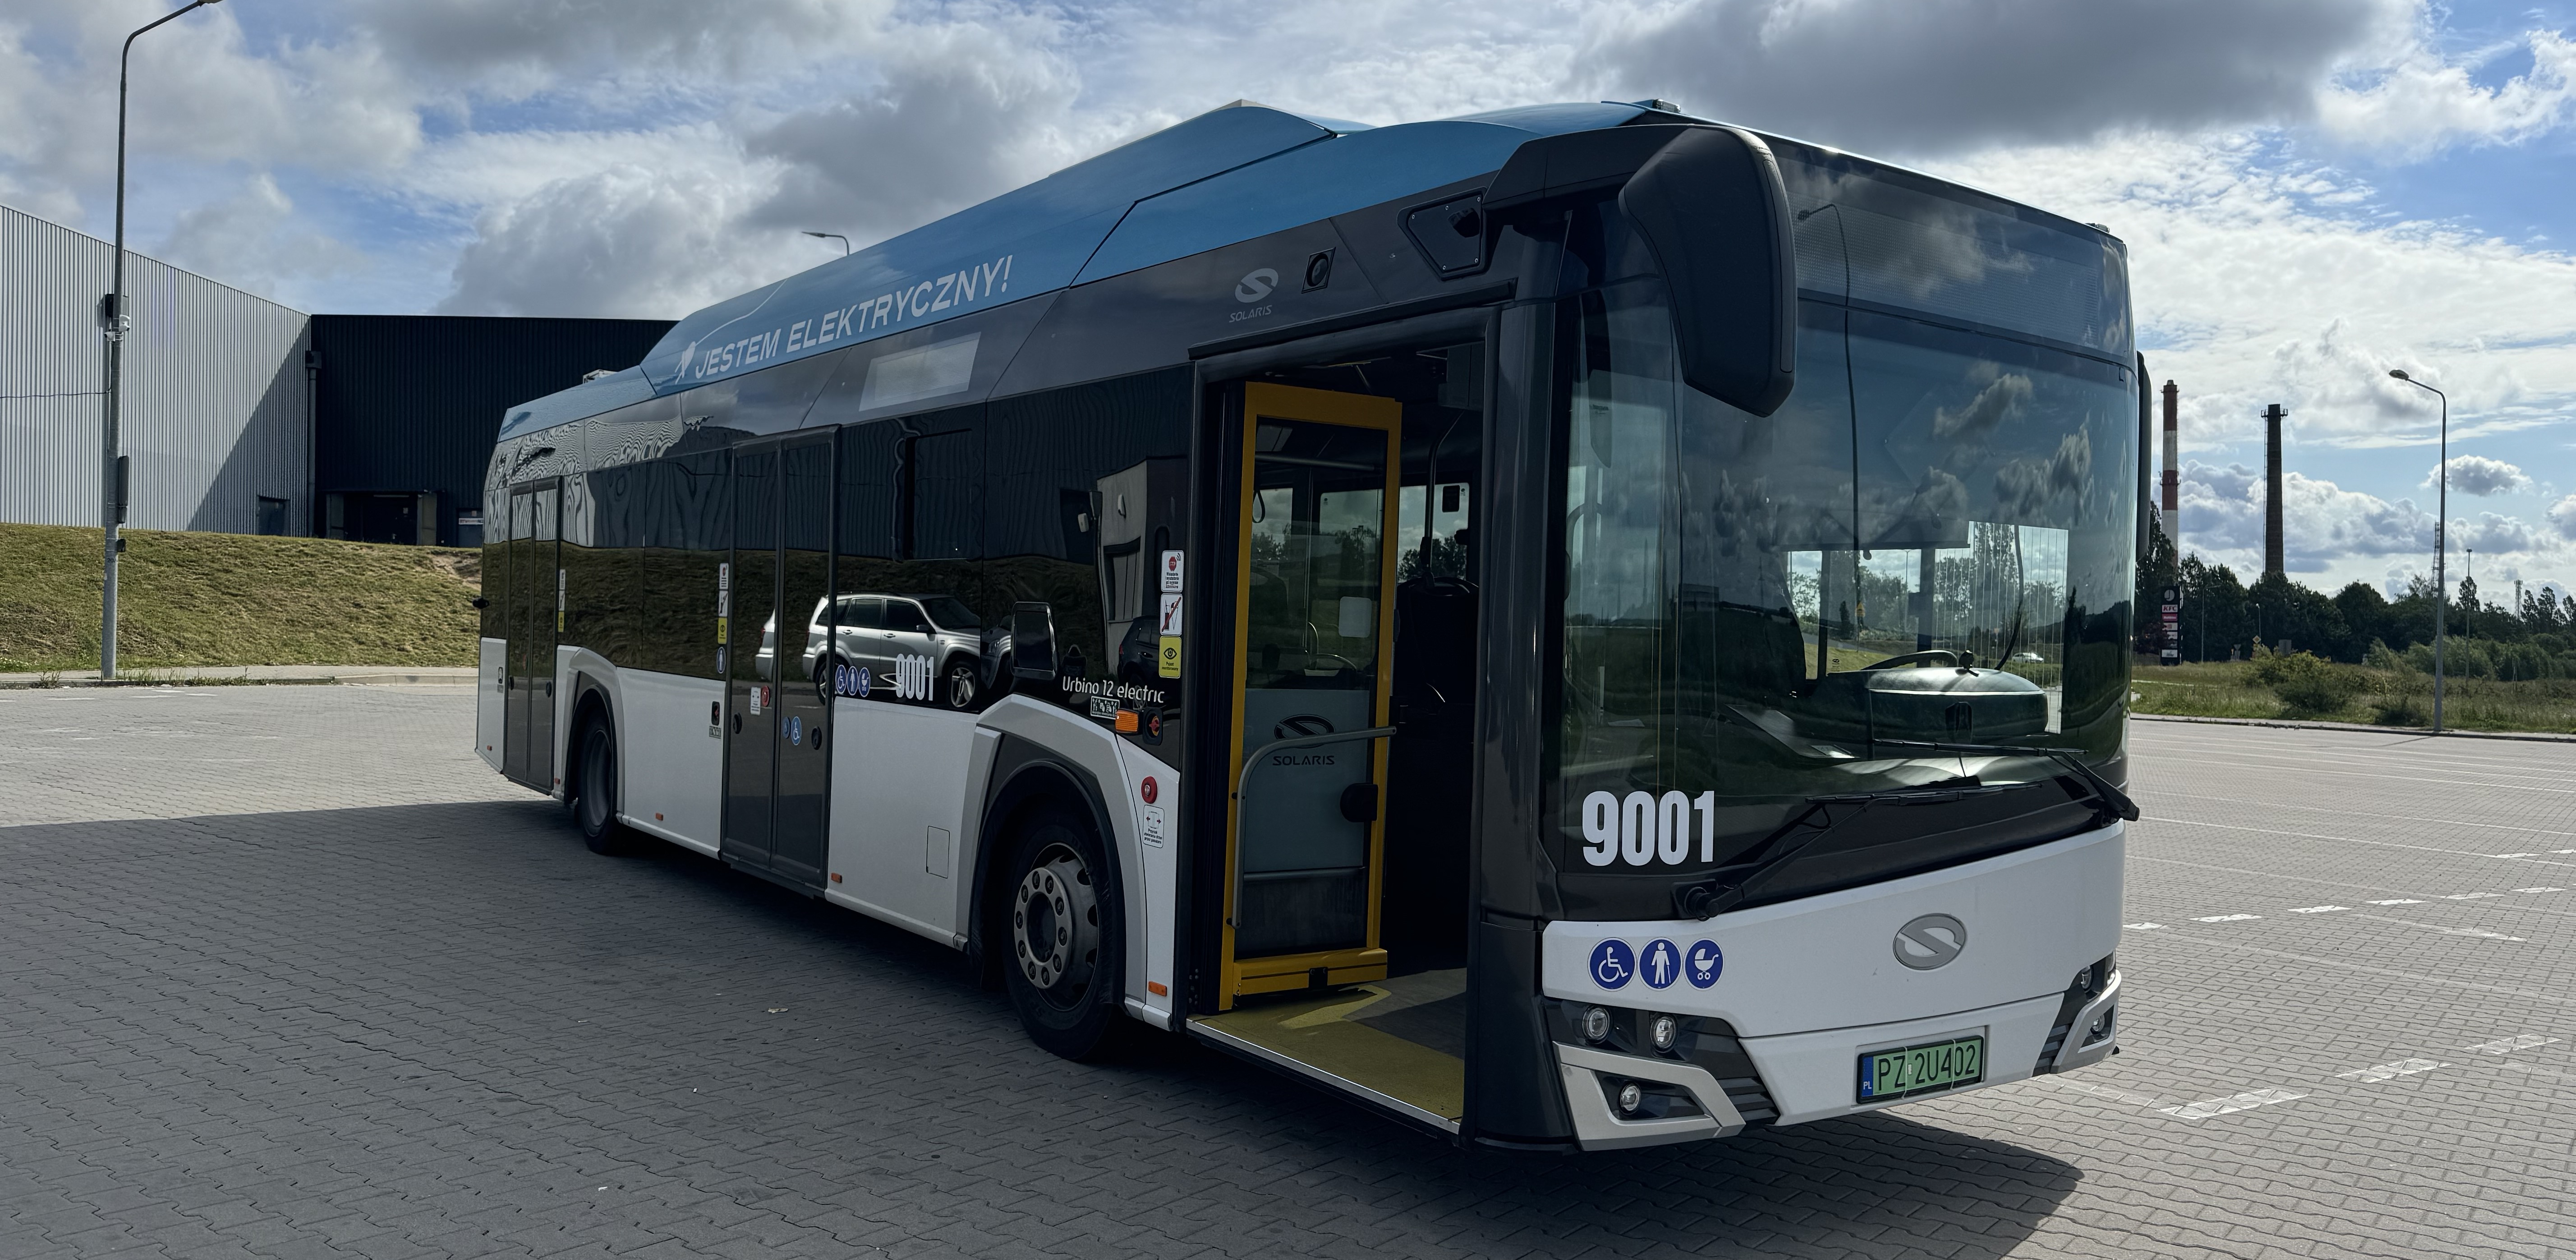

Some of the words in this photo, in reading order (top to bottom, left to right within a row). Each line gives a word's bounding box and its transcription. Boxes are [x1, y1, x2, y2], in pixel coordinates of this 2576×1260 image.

[695, 328, 781, 379] JESTEM
[786, 255, 1013, 353] ELEKTRYCZNY!
[1229, 305, 1272, 322] SOLARIS
[896, 653, 934, 701] 9001
[1063, 676, 1099, 694] Urbino
[1103, 680, 1114, 696] 12
[1117, 682, 1165, 703] electric
[1272, 755, 1335, 766] SOLARIS
[1582, 790, 1715, 866] 9001
[1863, 1081, 1872, 1090] PL
[1878, 1054, 1906, 1091] PZ
[1914, 1044, 1976, 1085] 2U402
